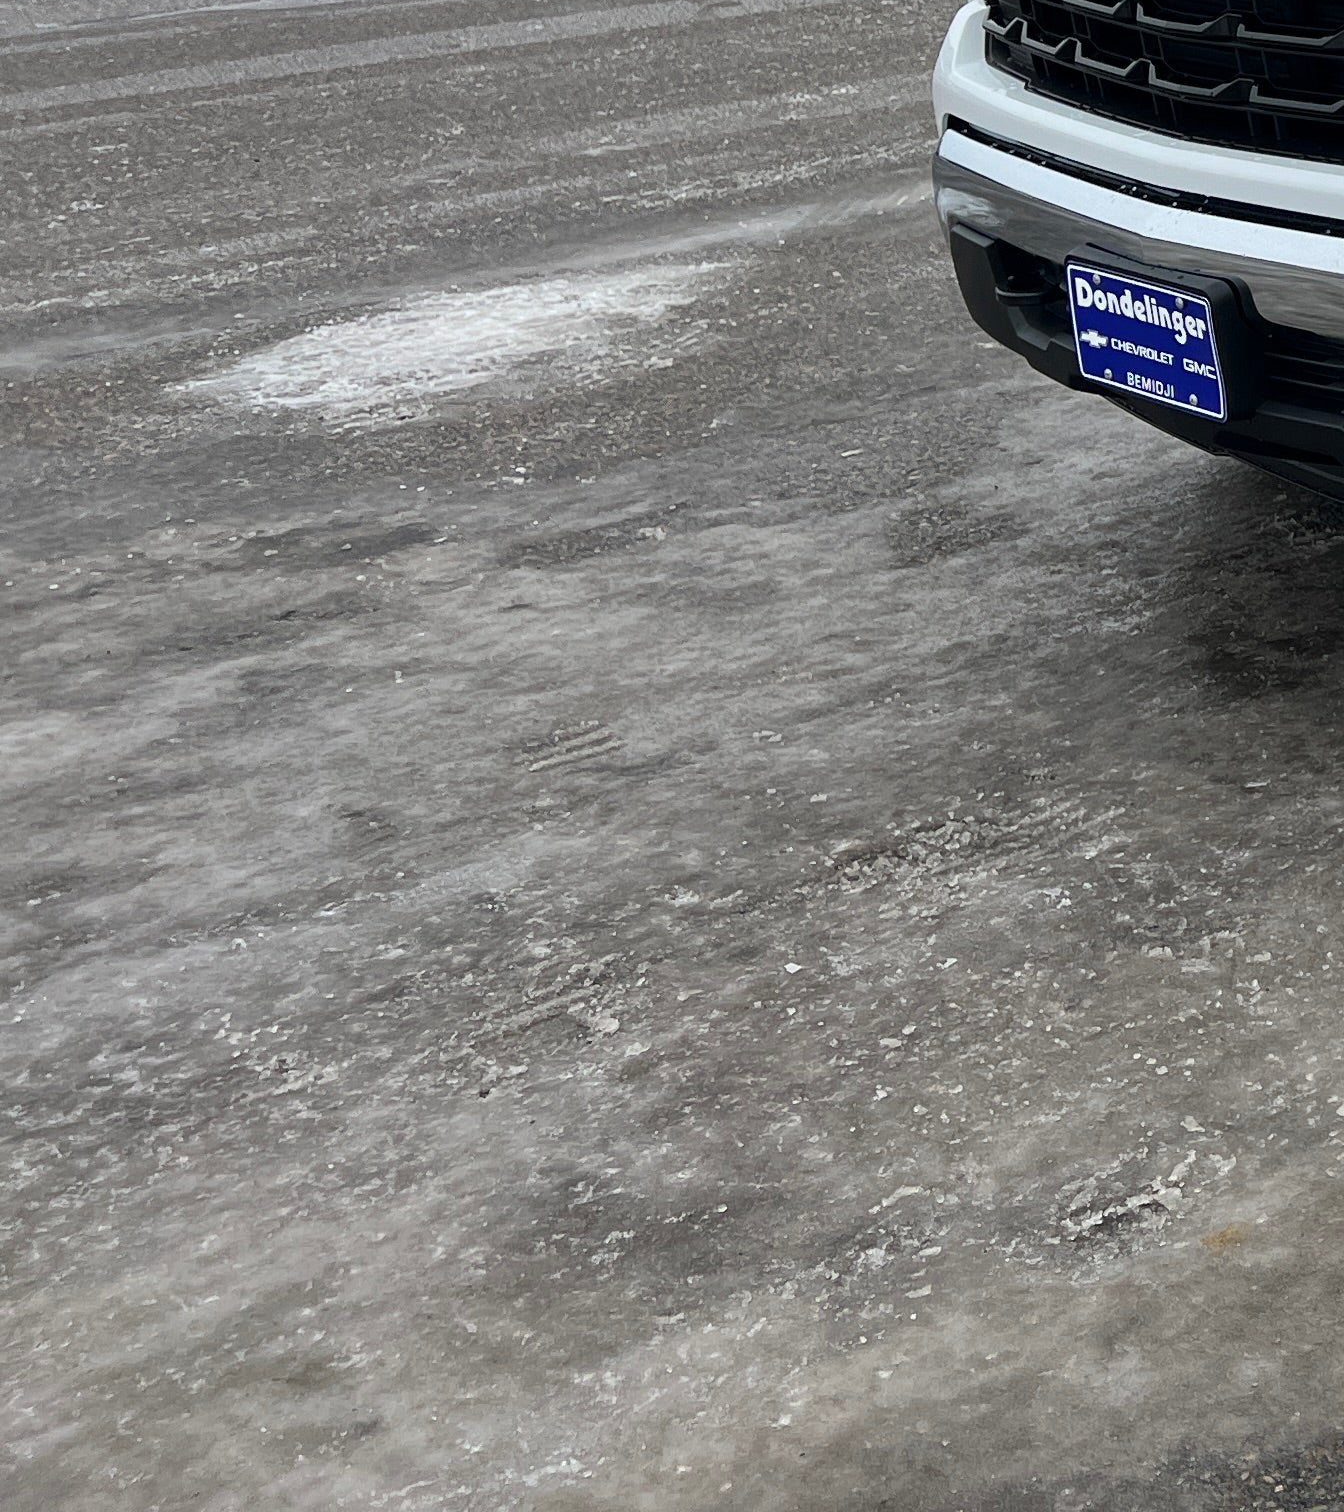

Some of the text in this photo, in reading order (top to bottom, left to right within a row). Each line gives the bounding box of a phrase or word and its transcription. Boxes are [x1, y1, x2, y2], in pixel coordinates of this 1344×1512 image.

[1074, 277, 1207, 345] Dondelinger
[1110, 338, 1217, 380] CHEVROLET GMC
[1126, 371, 1176, 399] BEMIDJI
